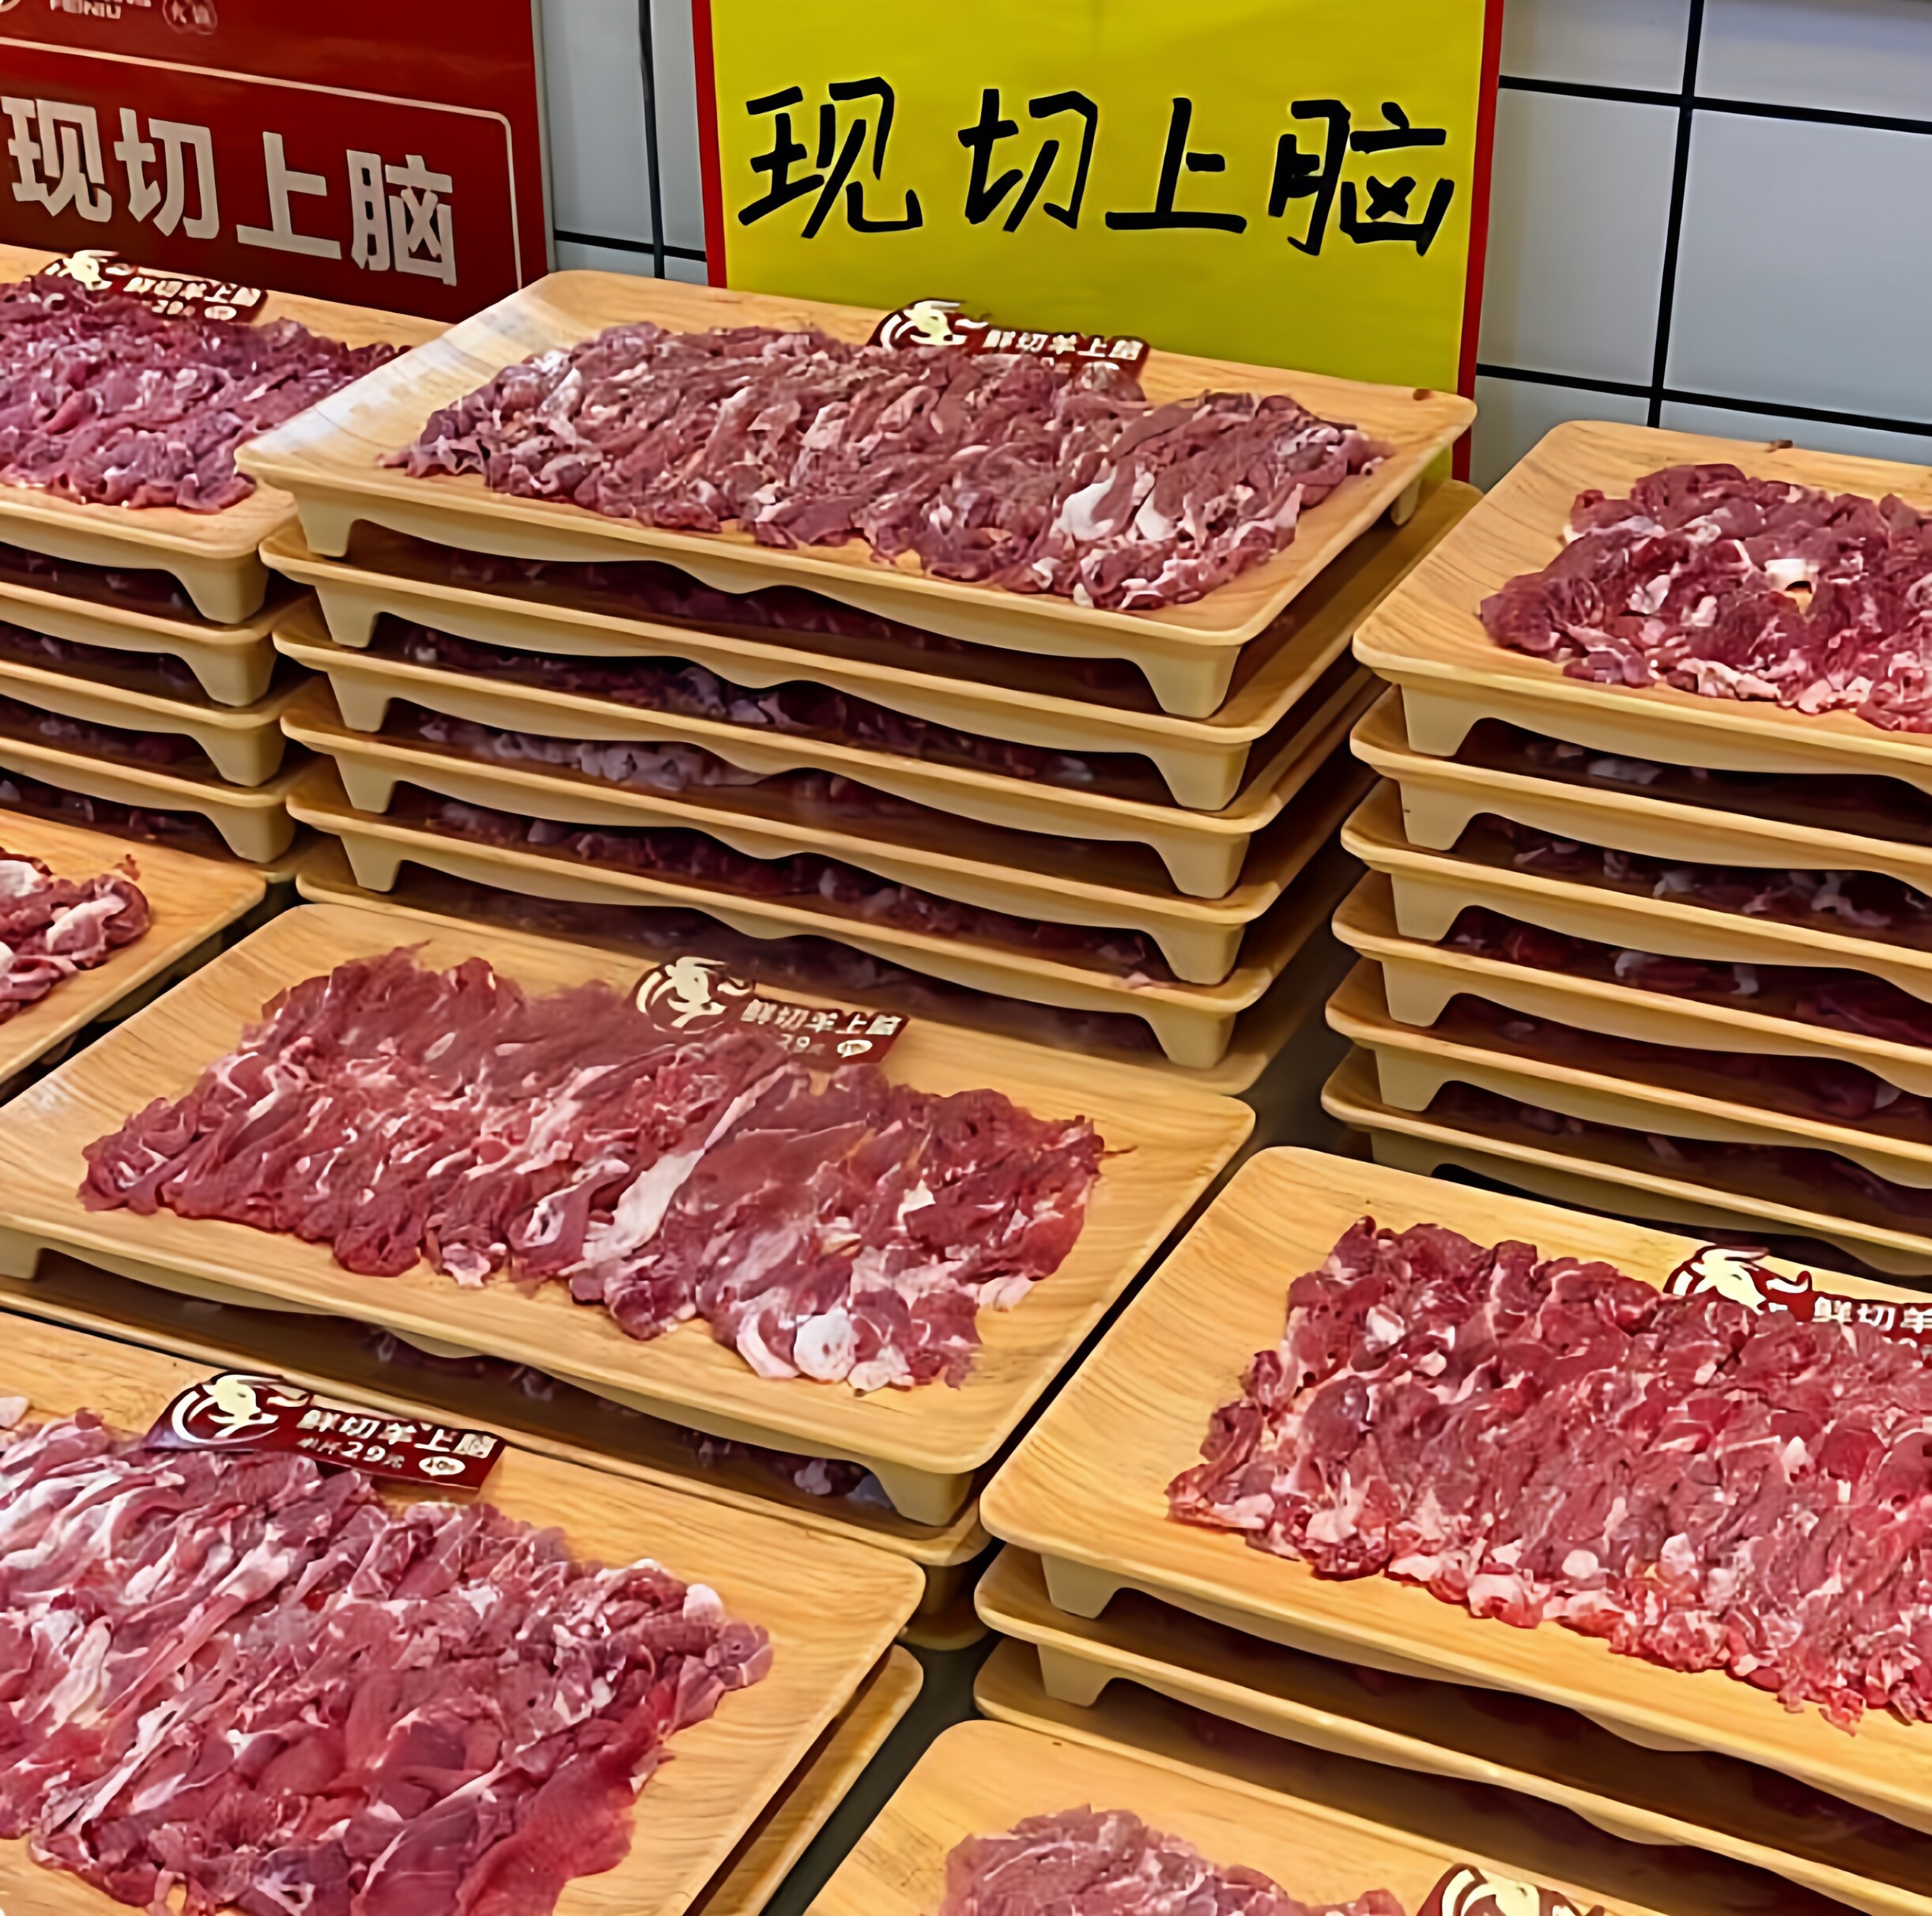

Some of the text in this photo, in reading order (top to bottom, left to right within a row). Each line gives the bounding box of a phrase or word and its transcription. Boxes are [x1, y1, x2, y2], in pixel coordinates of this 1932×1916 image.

[2, 95, 458, 287] 现切上脑
[737, 76, 1455, 256] 现切上脑
